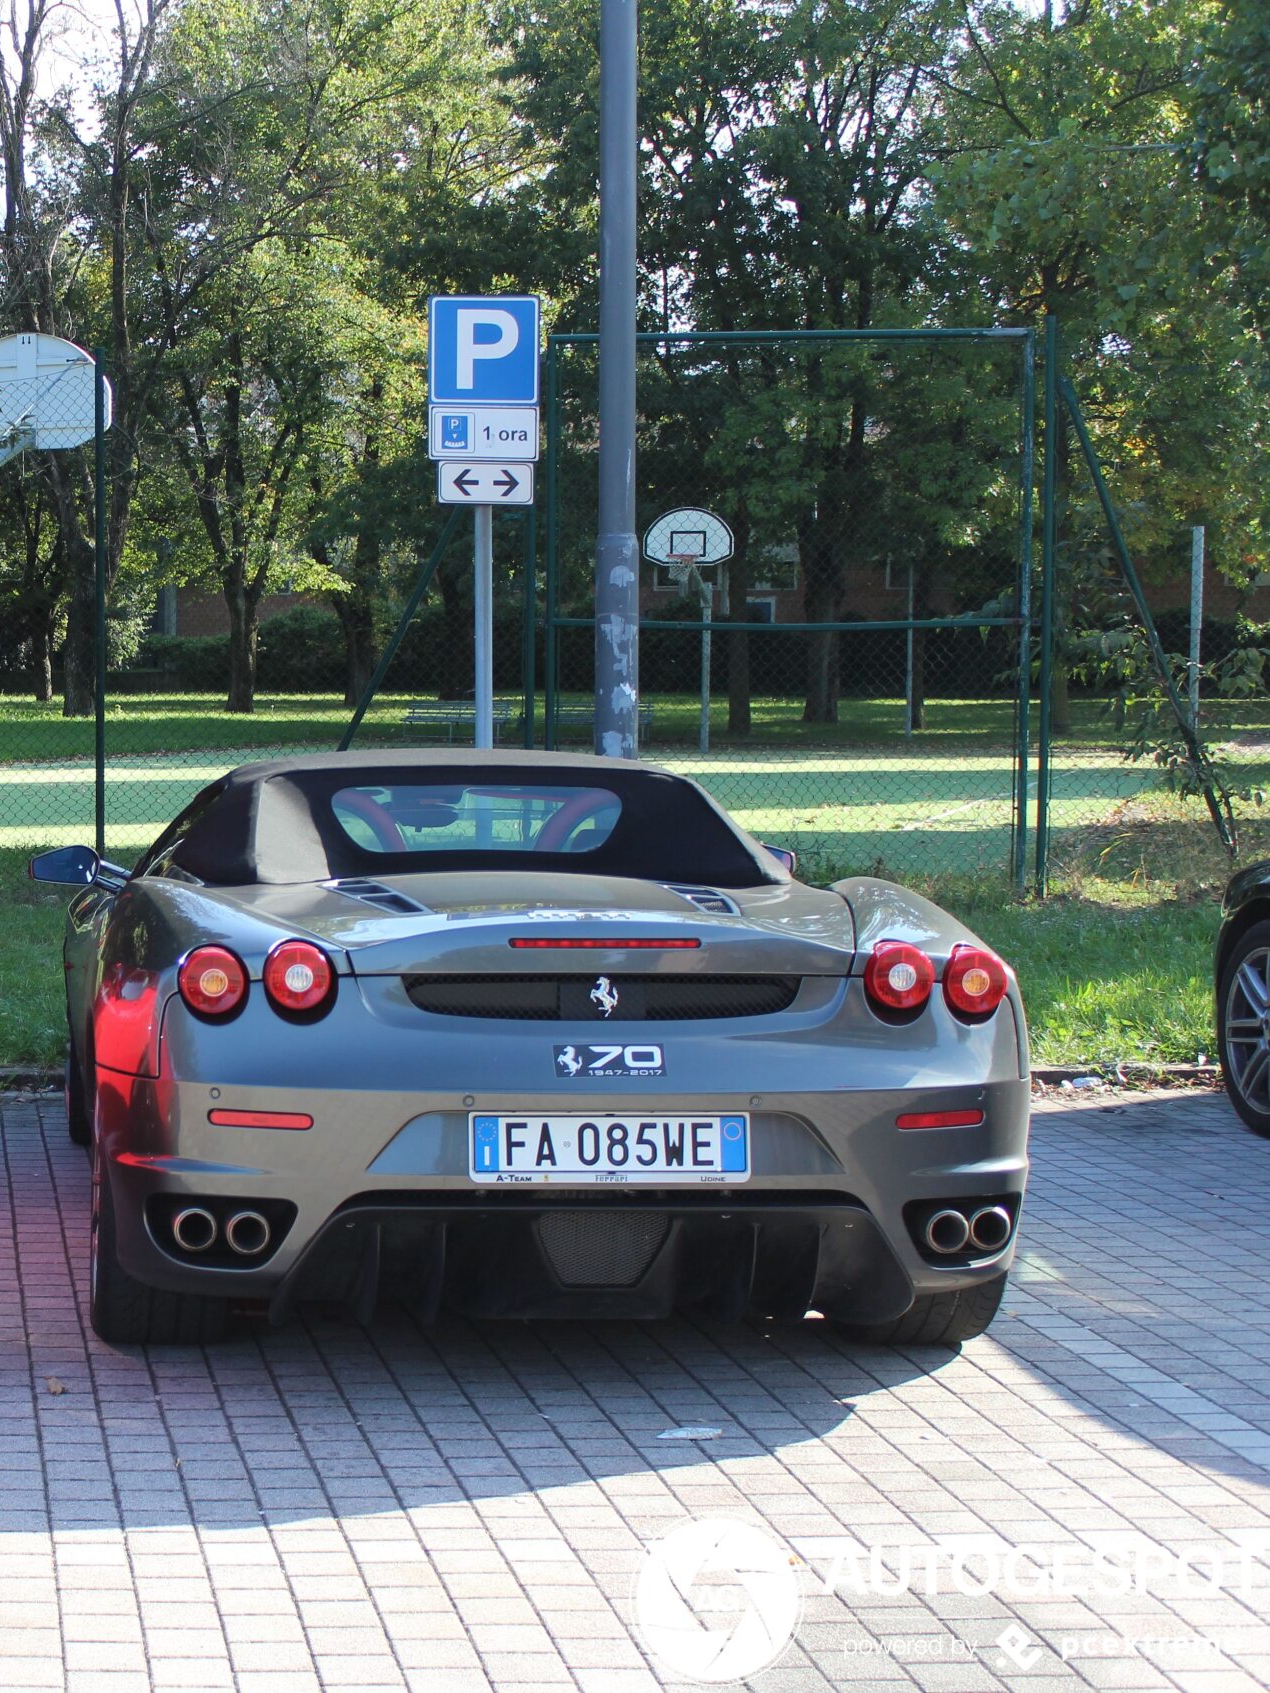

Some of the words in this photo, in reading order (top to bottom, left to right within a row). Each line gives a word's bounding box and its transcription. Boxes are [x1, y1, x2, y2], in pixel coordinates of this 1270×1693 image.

[456, 308, 519, 390] P
[450, 419, 459, 430] P
[482, 426, 491, 441] 1
[498, 428, 528, 442] ora
[588, 1045, 662, 1068] 70
[505, 1122, 557, 1167] FA
[577, 1122, 714, 1167] 085WE
